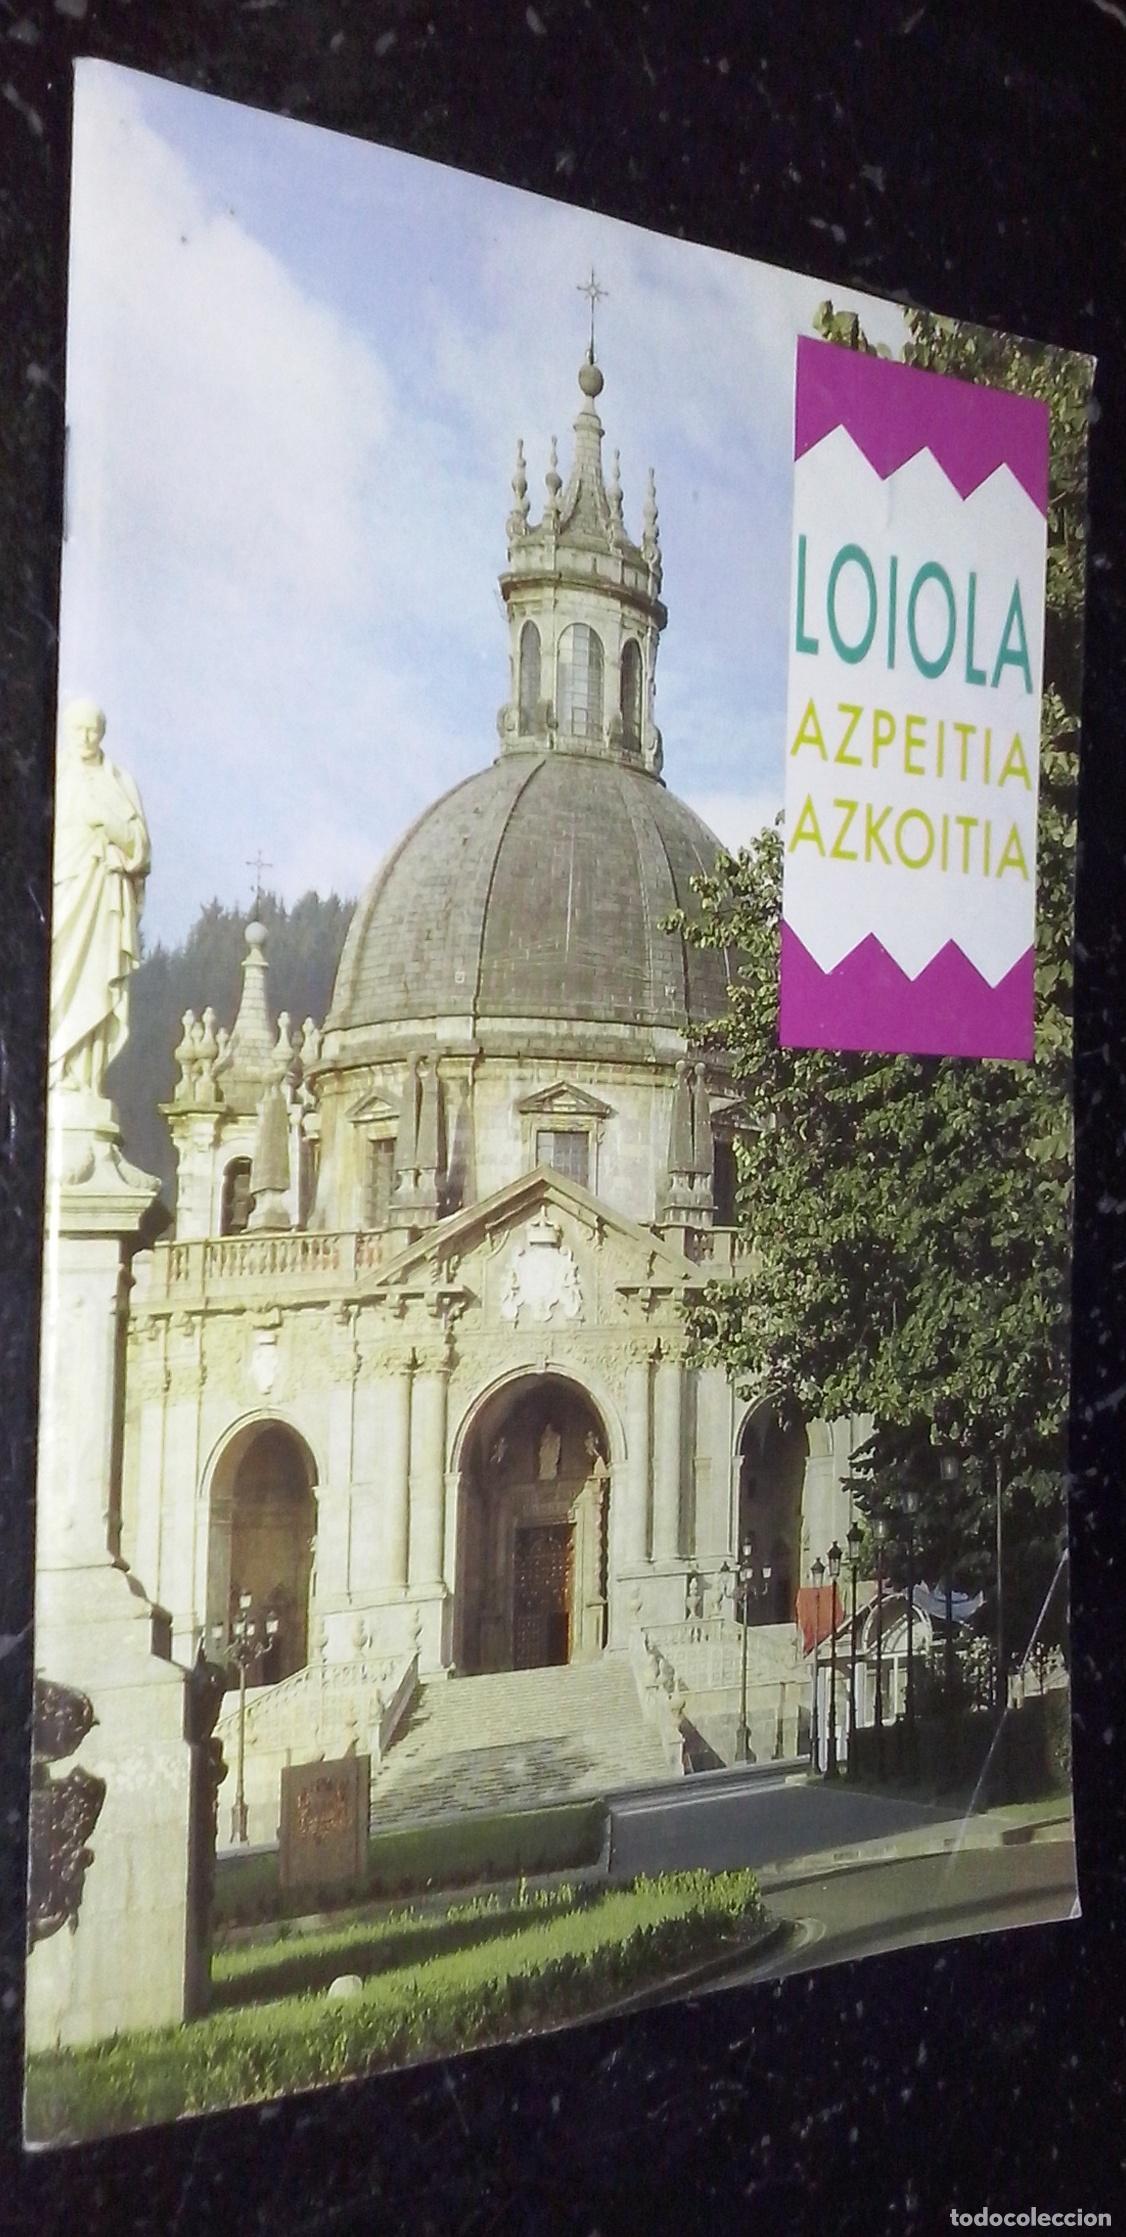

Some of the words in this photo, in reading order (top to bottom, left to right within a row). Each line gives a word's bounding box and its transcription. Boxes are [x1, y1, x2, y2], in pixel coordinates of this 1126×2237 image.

[796, 534, 1033, 694] LOIOLA
[790, 697, 1032, 791] AZPEITIA
[788, 793, 1030, 881] AZKOITIA
